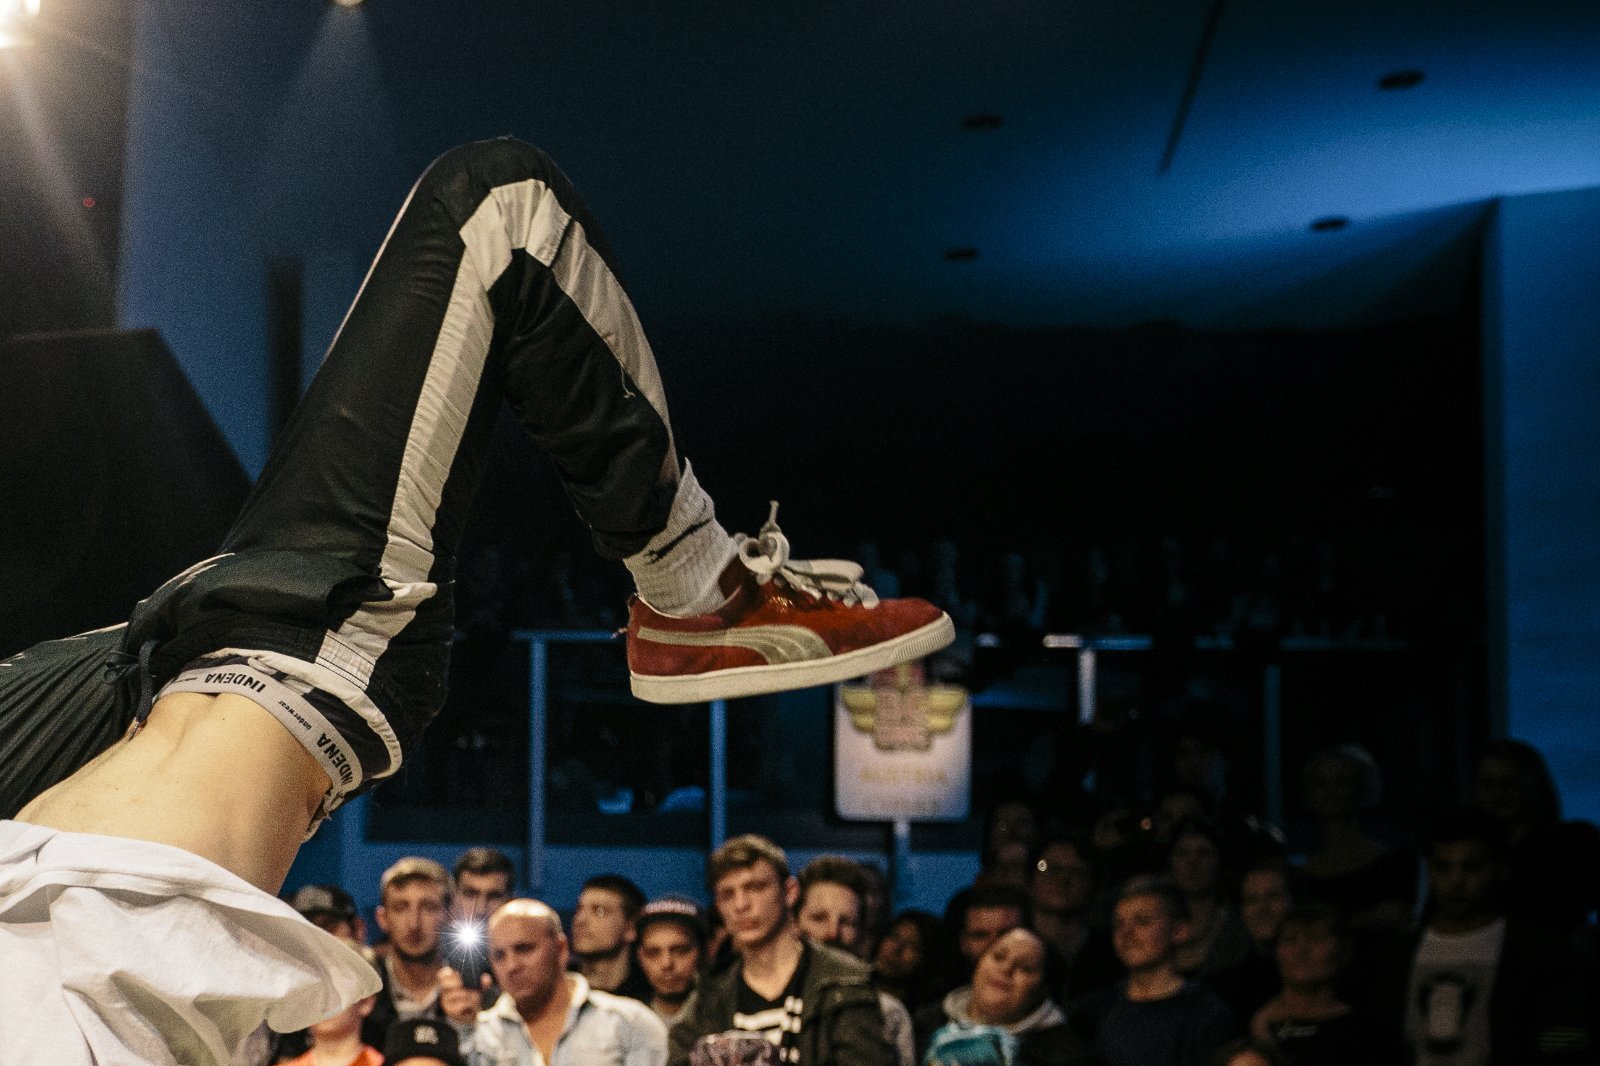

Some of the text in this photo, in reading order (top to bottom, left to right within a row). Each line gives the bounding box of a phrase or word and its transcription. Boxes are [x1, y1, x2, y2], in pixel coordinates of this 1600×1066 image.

[204, 672, 354, 786] INDENA underwear INDENA
